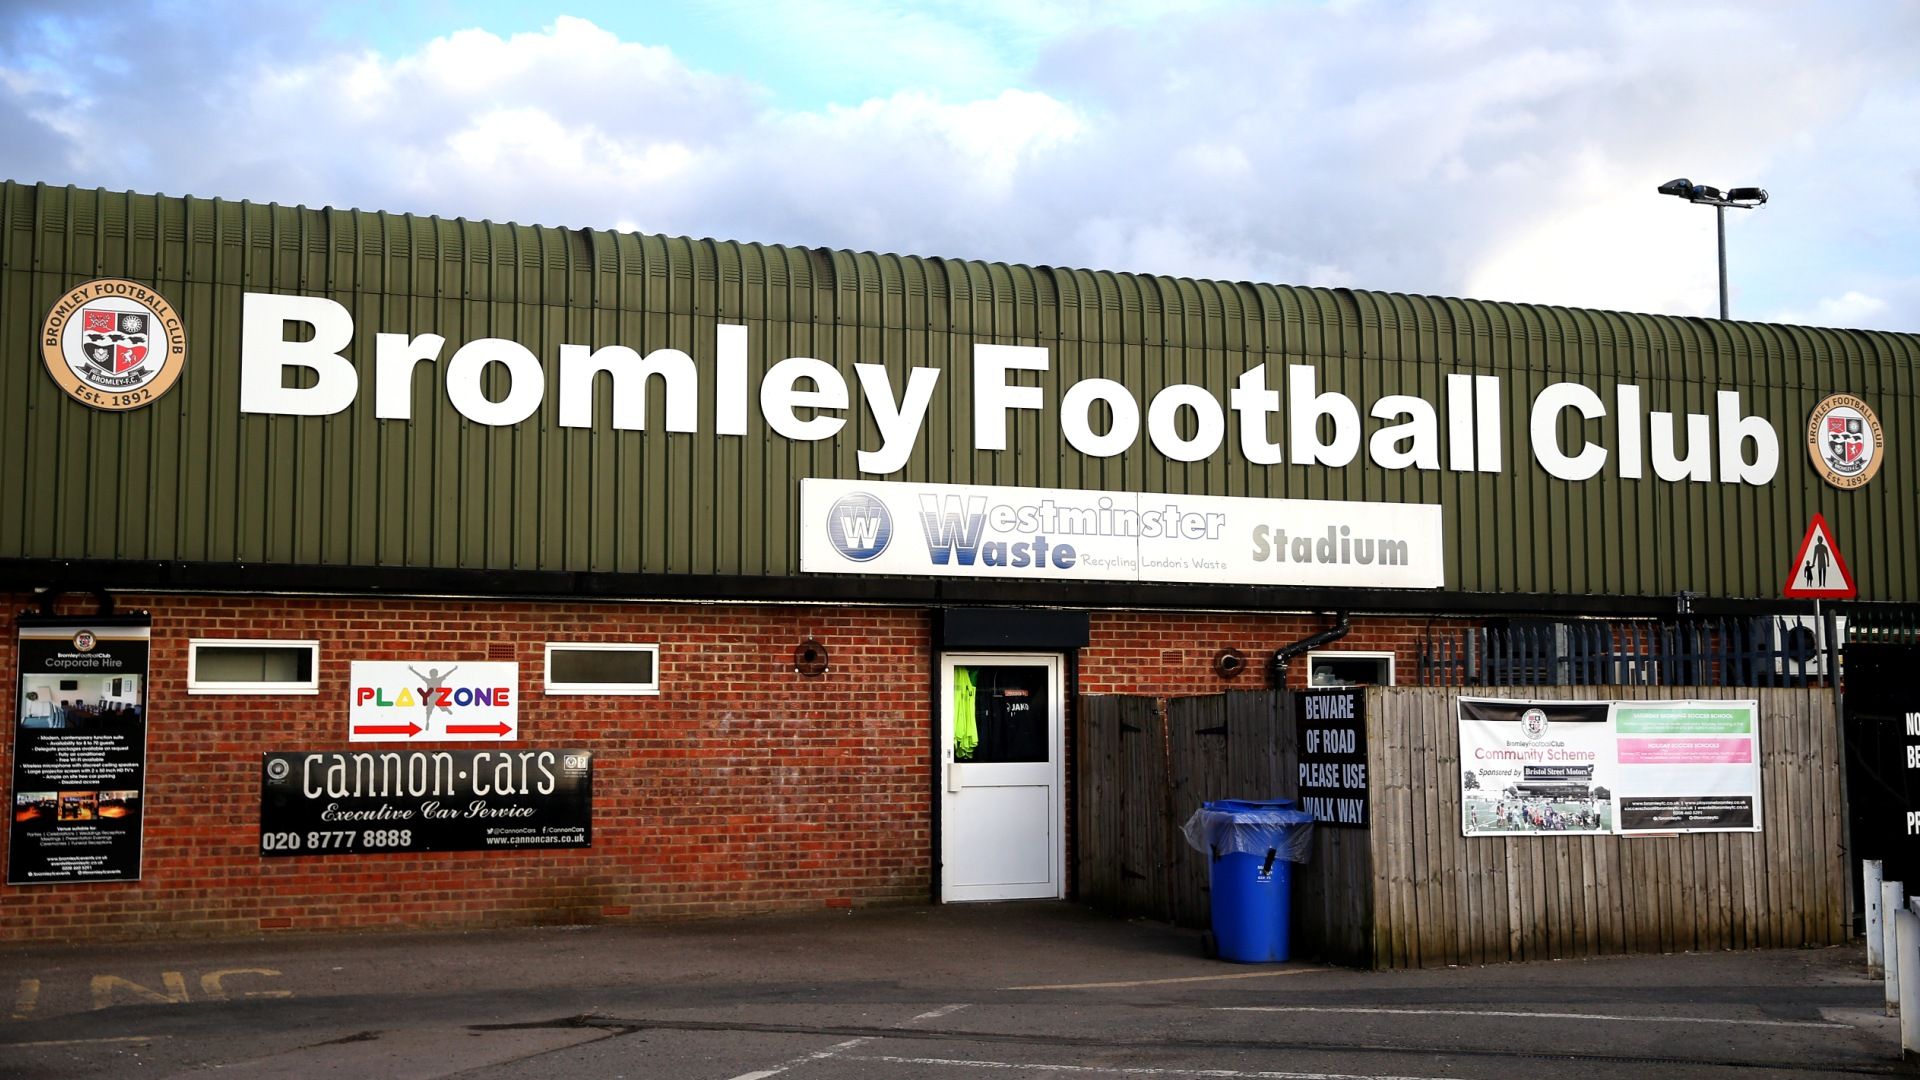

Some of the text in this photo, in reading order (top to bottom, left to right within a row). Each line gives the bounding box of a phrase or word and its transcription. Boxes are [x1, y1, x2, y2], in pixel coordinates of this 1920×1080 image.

[46, 283, 183, 354] BROMLEY FOOTBALL CLUB
[75, 385, 152, 406] Est. 1892
[241, 292, 1781, 485] Bromley Football Club
[1810, 397, 1883, 448] BROMLEY FOOTBALL CLUB
[1826, 472, 1868, 486] Est. 1892
[918, 493, 1410, 567] Westminster Stadium
[919, 511, 1077, 569] Waste
[1081, 553, 1228, 572] Recycling London's Waste
[45, 658, 122, 669] Corporate Hire
[357, 687, 510, 708] PLAYZONE
[1305, 694, 1354, 719] BEWARE
[1306, 729, 1356, 754] OF ROAD
[1474, 747, 1596, 763] Community Scheme
[1299, 763, 1366, 789] PLEASE USE
[1478, 767, 1588, 778] Sponsored by Bristol Street Motors
[320, 800, 537, 823] Executive Car Service
[1303, 797, 1364, 824] WALK WAY
[262, 829, 412, 851] 020 8777 8888
[486, 834, 585, 844] www.cannoncars.co.uk
